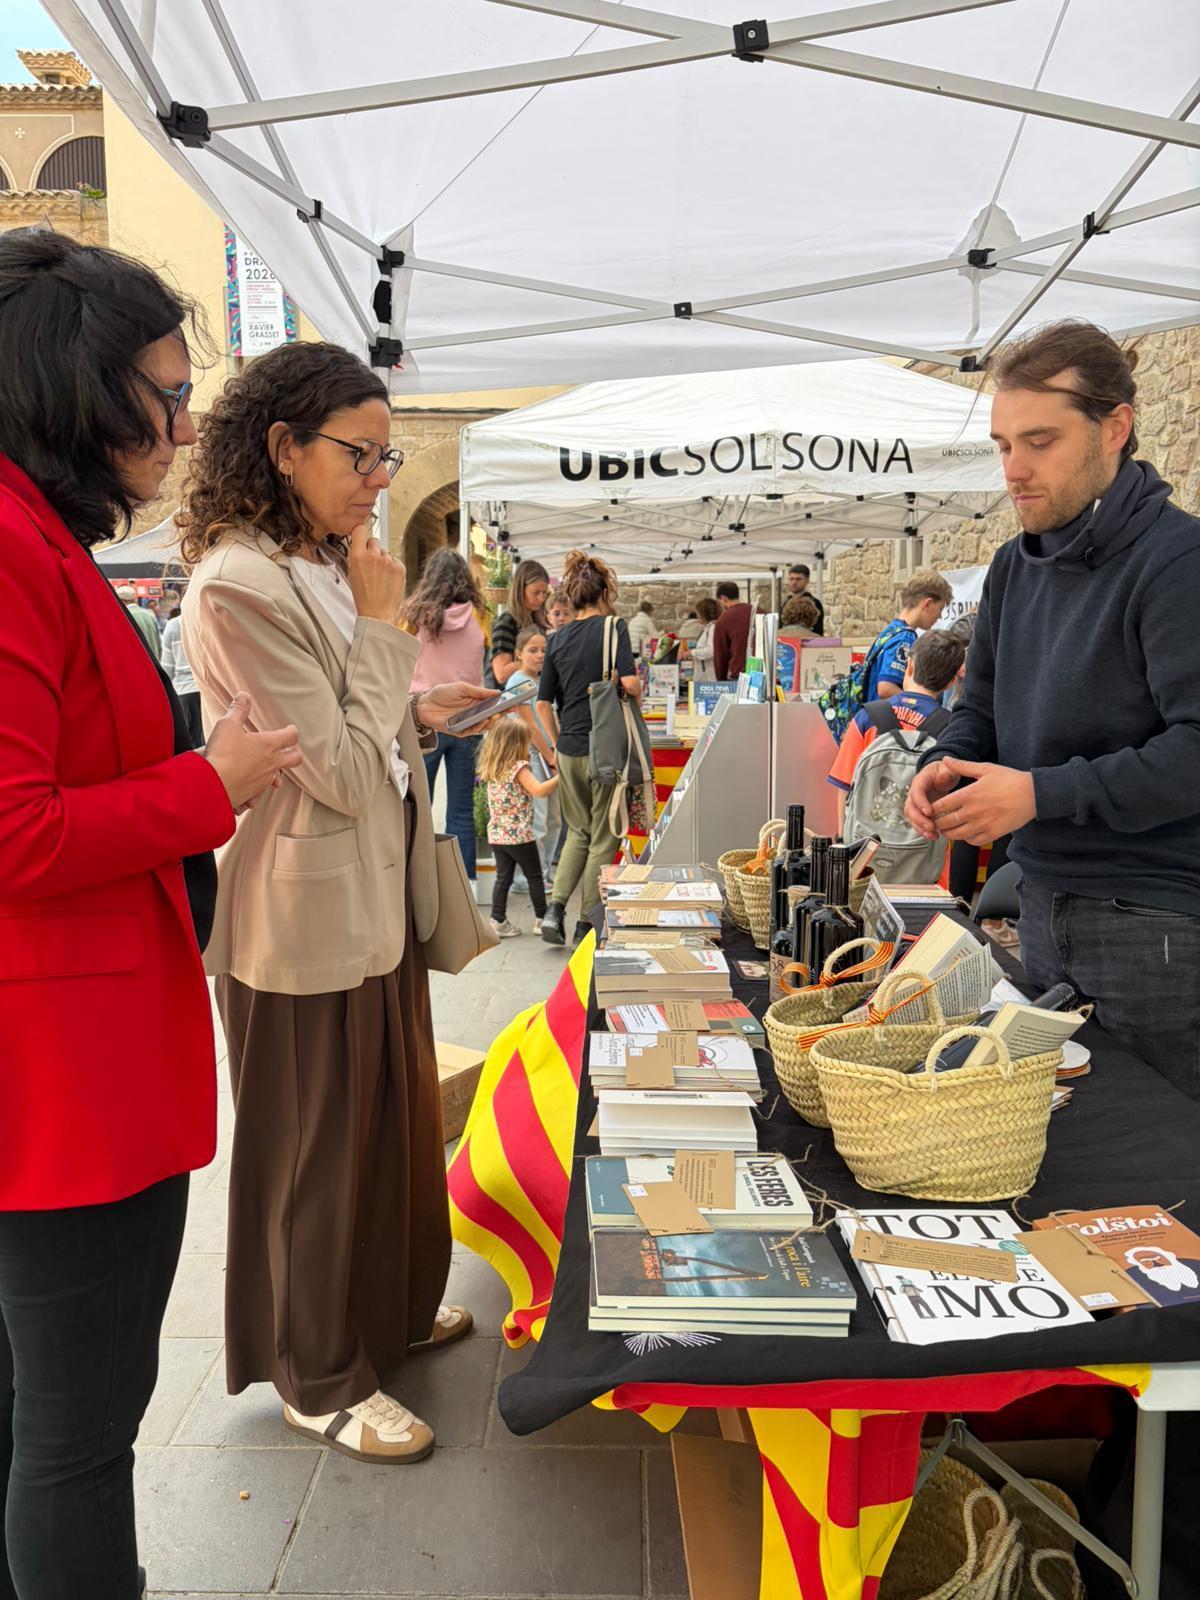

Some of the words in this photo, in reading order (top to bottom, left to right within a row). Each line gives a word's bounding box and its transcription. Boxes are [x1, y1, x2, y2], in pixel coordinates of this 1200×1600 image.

[245, 257, 263, 265] DR
[753, 1178, 794, 1207] FERES
[861, 1214, 1004, 1240] TOT
